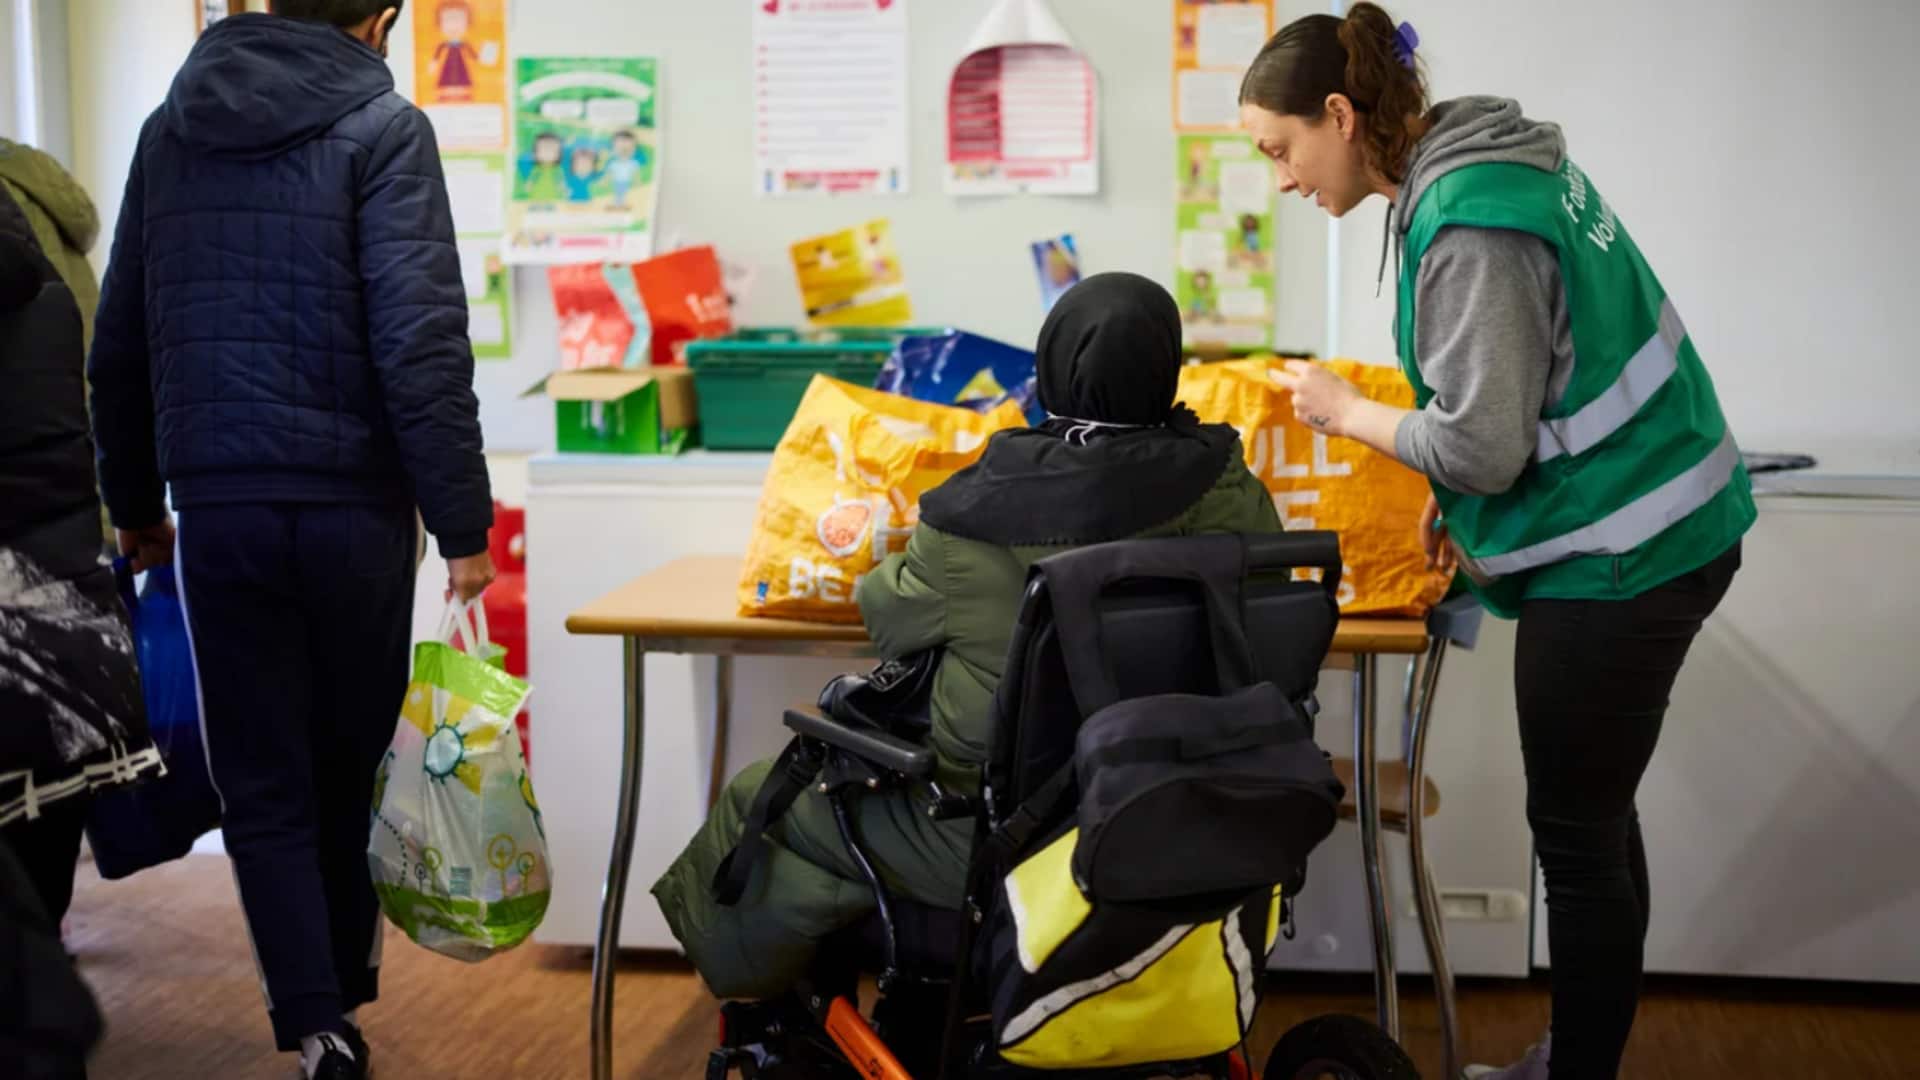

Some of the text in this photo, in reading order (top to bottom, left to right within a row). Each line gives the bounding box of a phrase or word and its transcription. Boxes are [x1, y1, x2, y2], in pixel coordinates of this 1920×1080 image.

[1561, 160, 1586, 224] Food
[1586, 207, 1617, 252] Vol
[788, 557, 862, 604] BE
